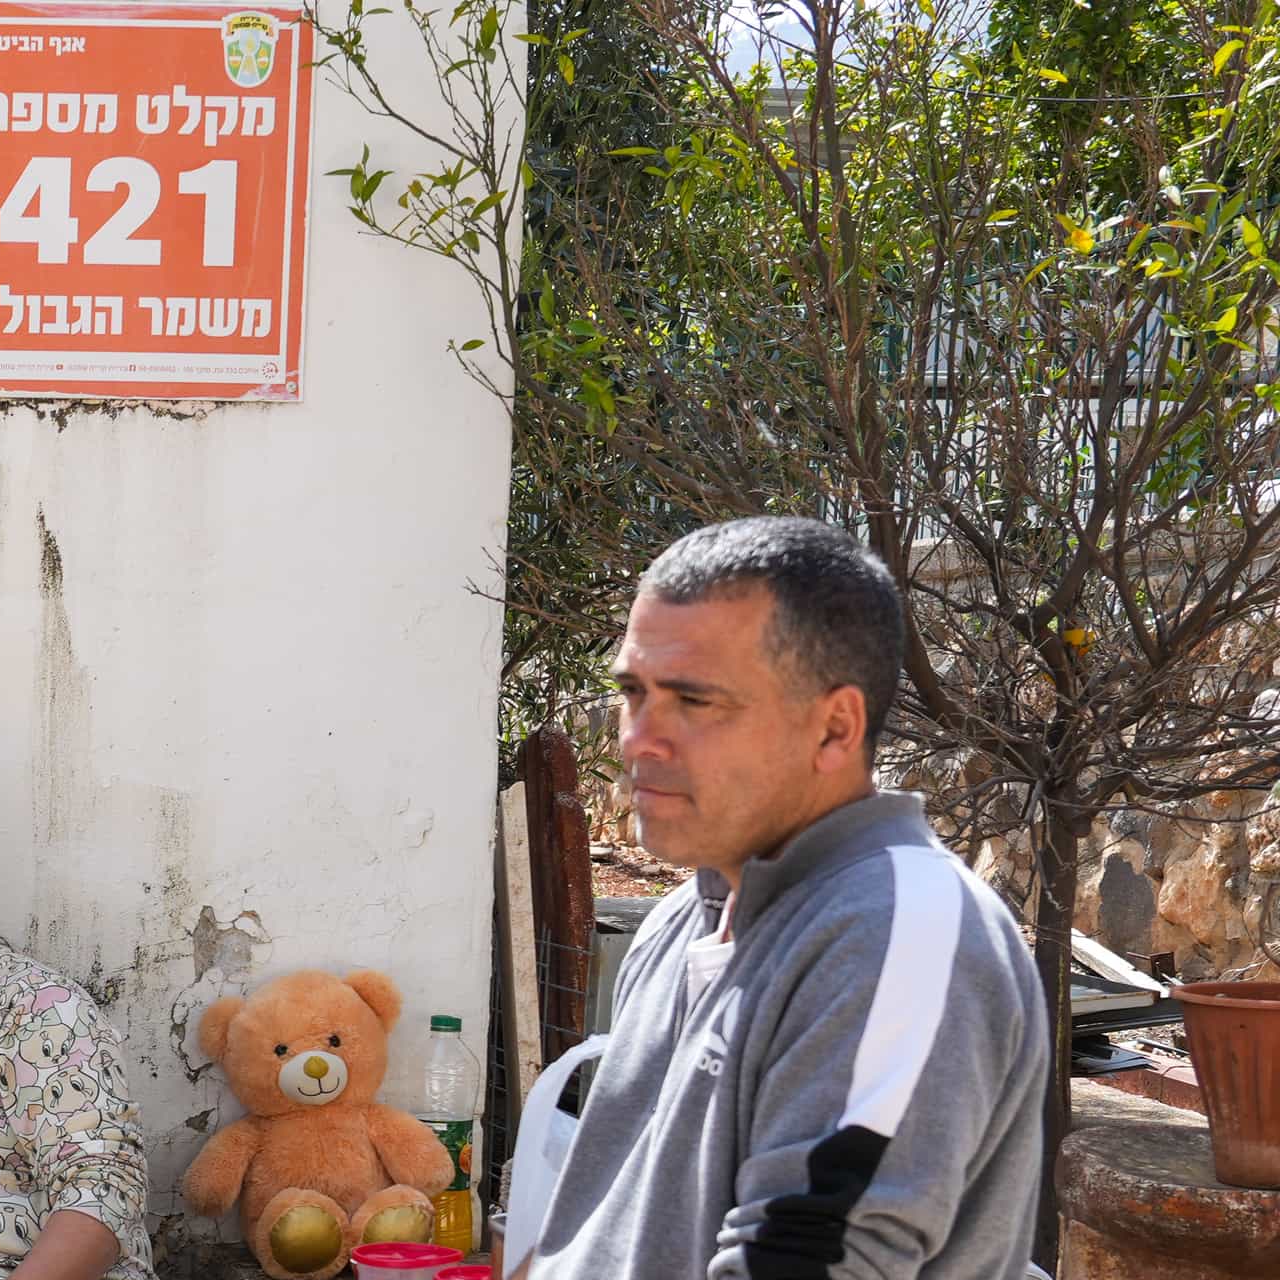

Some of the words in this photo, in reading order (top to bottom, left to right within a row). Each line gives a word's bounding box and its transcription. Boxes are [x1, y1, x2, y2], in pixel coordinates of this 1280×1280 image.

[48, 36, 87, 57] אגף
[136, 84, 276, 147] מקלט
[138, 296, 273, 338] משמר
